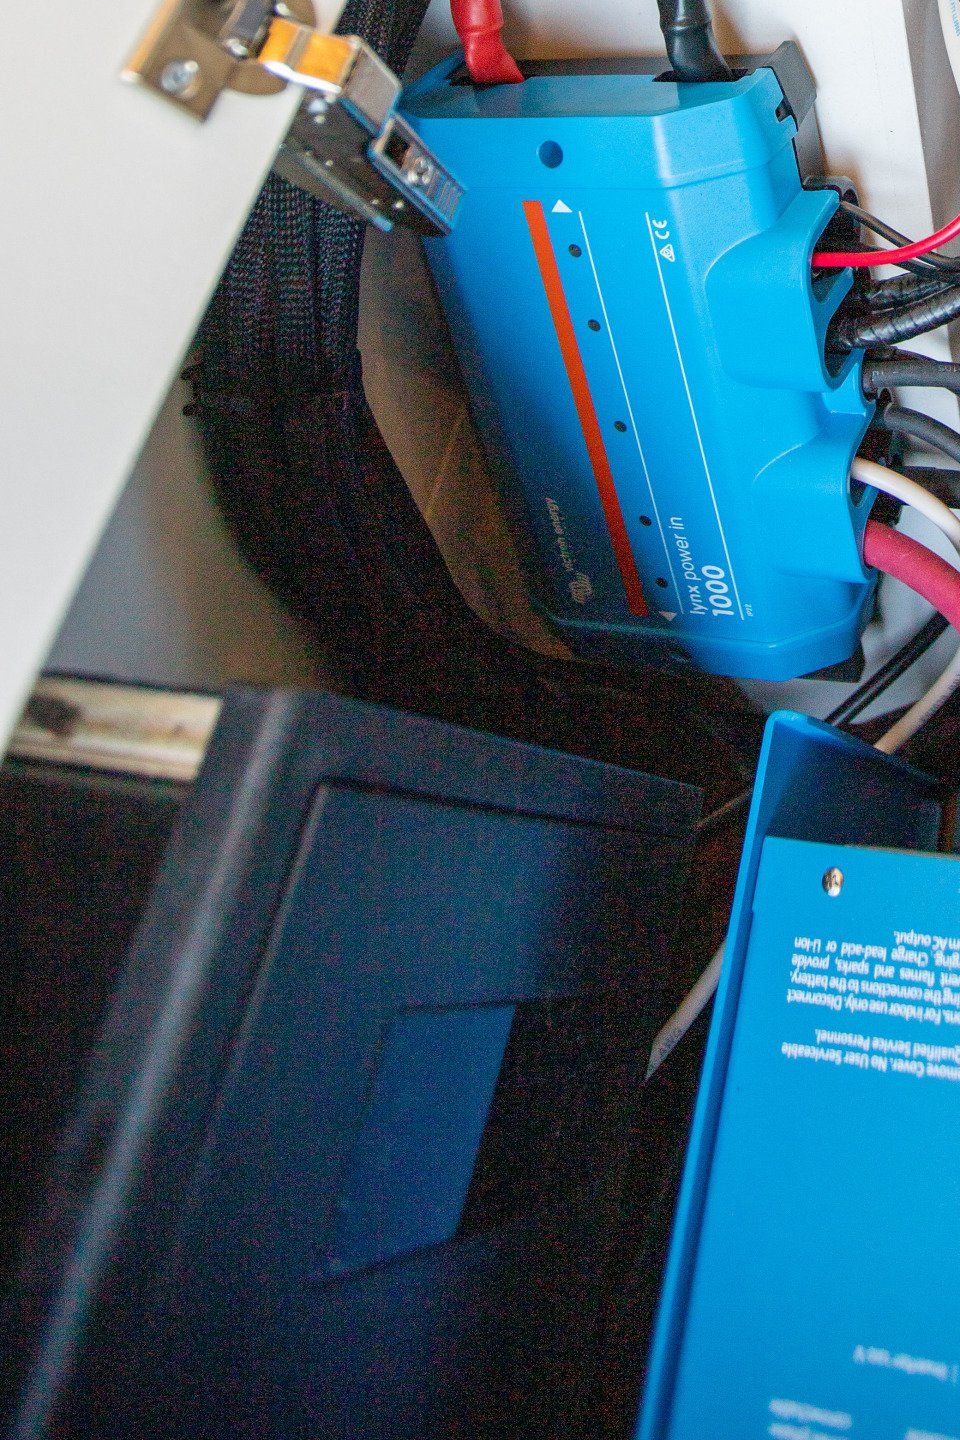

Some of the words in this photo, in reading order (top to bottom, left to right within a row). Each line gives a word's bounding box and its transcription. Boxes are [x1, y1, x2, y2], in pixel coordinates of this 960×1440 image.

[668, 516, 685, 530] in
[672, 533, 701, 581] power
[701, 564, 735, 617] 1000
[687, 585, 708, 616] lynx
[825, 941, 837, 953] or
[841, 942, 886, 961] lead-acid
[932, 936, 947, 950] AC
[792, 954, 829, 968] provide
[891, 946, 928, 966] Charge
[874, 964, 894, 979] and
[900, 968, 934, 987] flames
[829, 977, 846, 992] the
[847, 979, 859, 993] to
[861, 981, 922, 999] connections
[787, 989, 842, 1010] Disconnect
[924, 989, 940, 1005] the
[868, 1000, 887, 1013] use
[889, 1003, 923, 1021] indoor
[924, 1008, 941, 1024] For
[781, 1043, 842, 1064] Serviceable
[873, 1037, 910, 1057] Service
[844, 1051, 868, 1069] User
[871, 1056, 887, 1071] No
